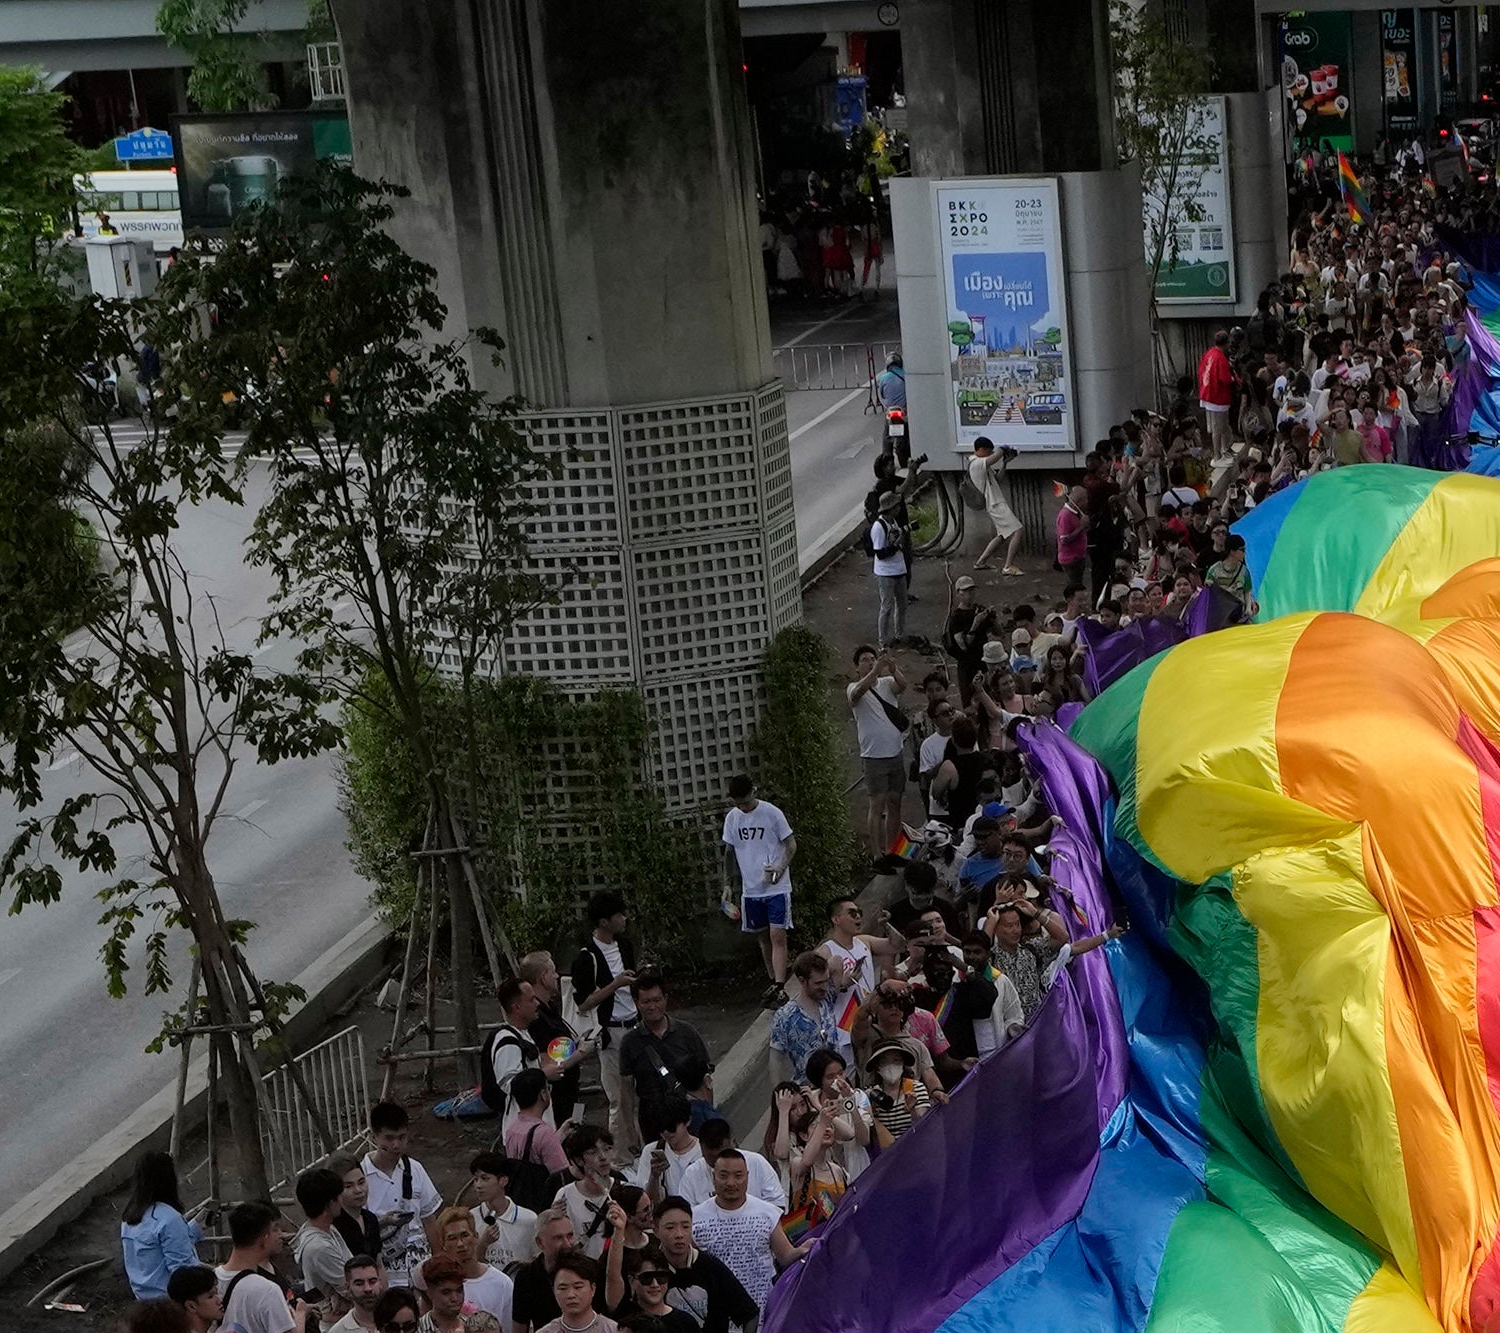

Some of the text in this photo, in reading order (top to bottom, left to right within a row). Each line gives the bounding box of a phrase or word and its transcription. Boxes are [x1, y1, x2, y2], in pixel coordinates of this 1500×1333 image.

[1285, 32, 1311, 45] Grab
[1015, 199, 1042, 209] 20-23
[950, 226, 988, 236] 2024
[738, 827, 764, 840] 1977
